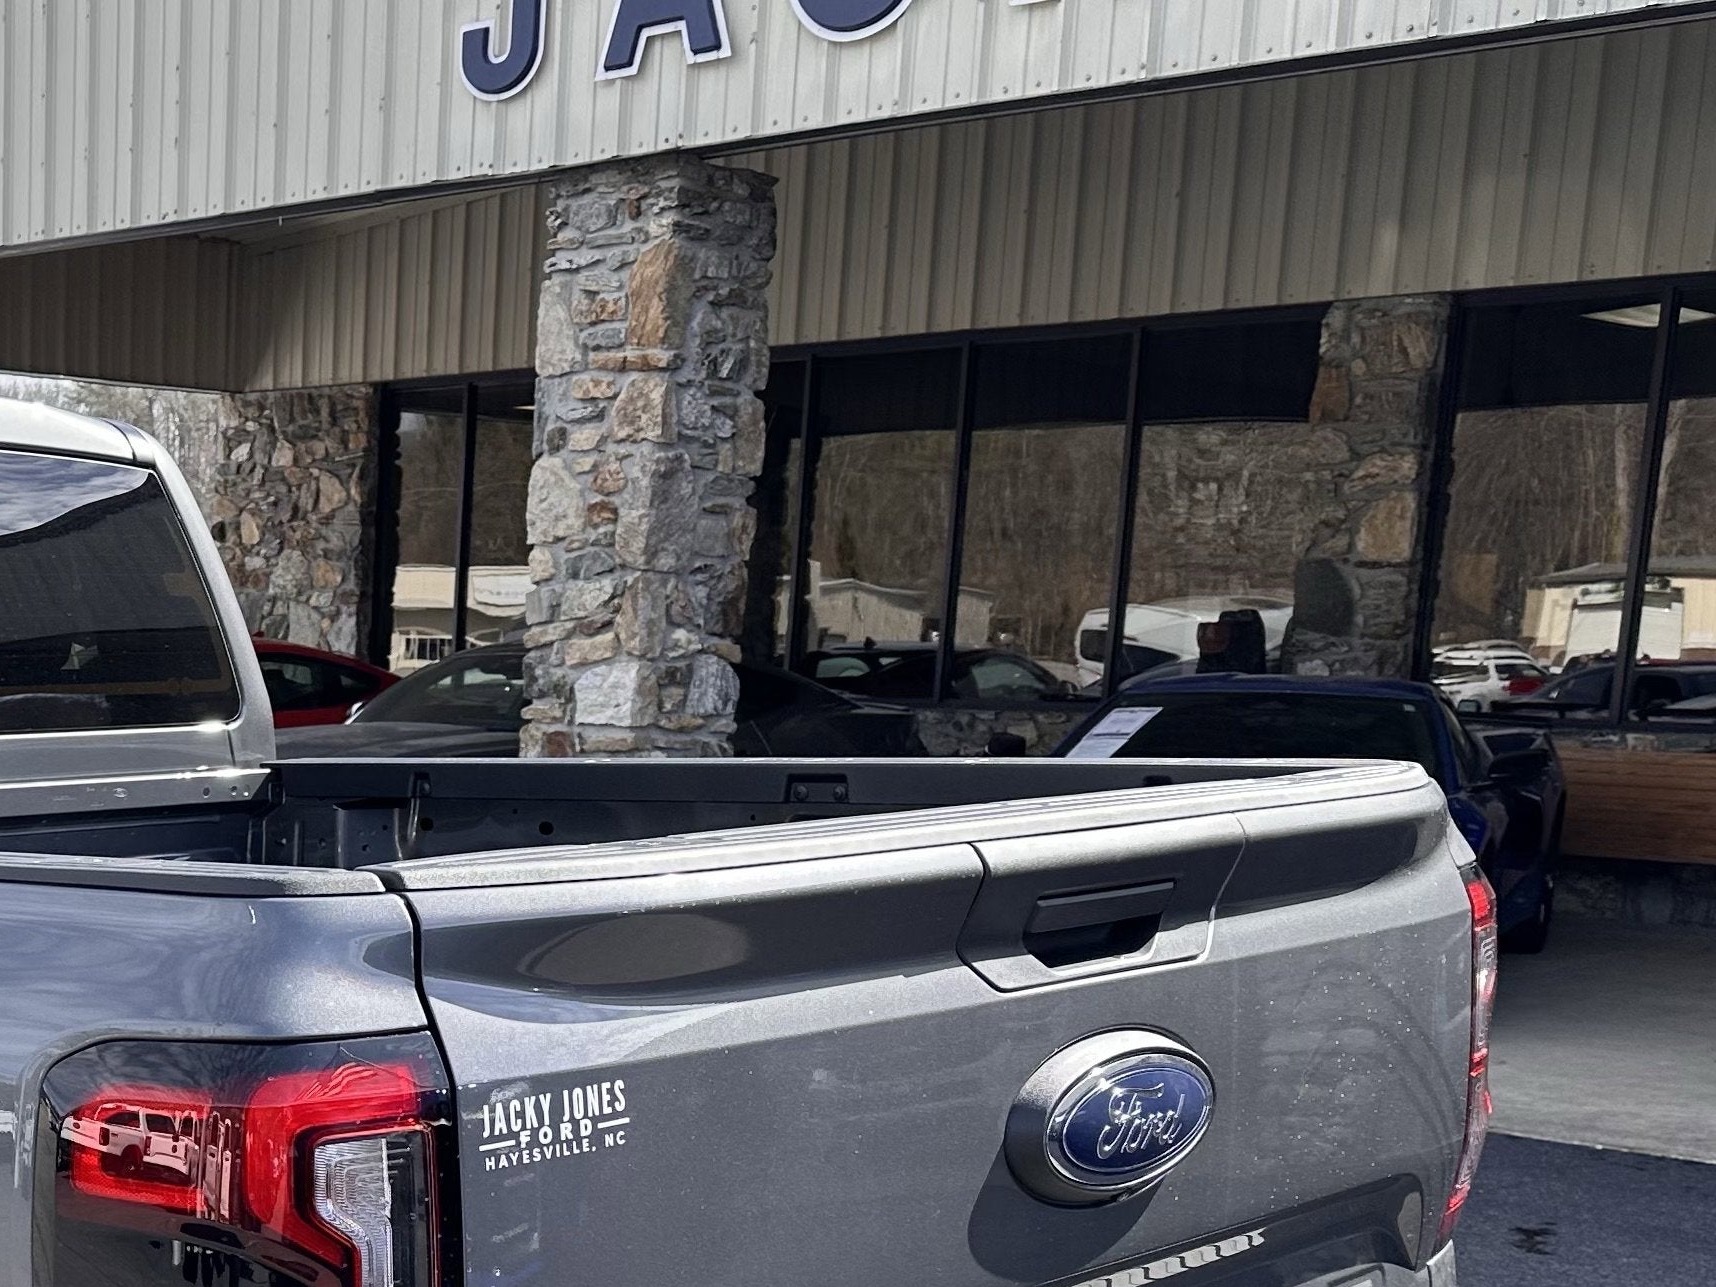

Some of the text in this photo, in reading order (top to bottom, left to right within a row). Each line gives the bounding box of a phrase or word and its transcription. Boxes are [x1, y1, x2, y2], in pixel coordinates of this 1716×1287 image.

[482, 1080, 626, 1138] JACKY JONES
[519, 1118, 593, 1149] FORD
[1096, 1082, 1186, 1160] Ford
[485, 1130, 627, 1171] HAYESVILLE, NC
